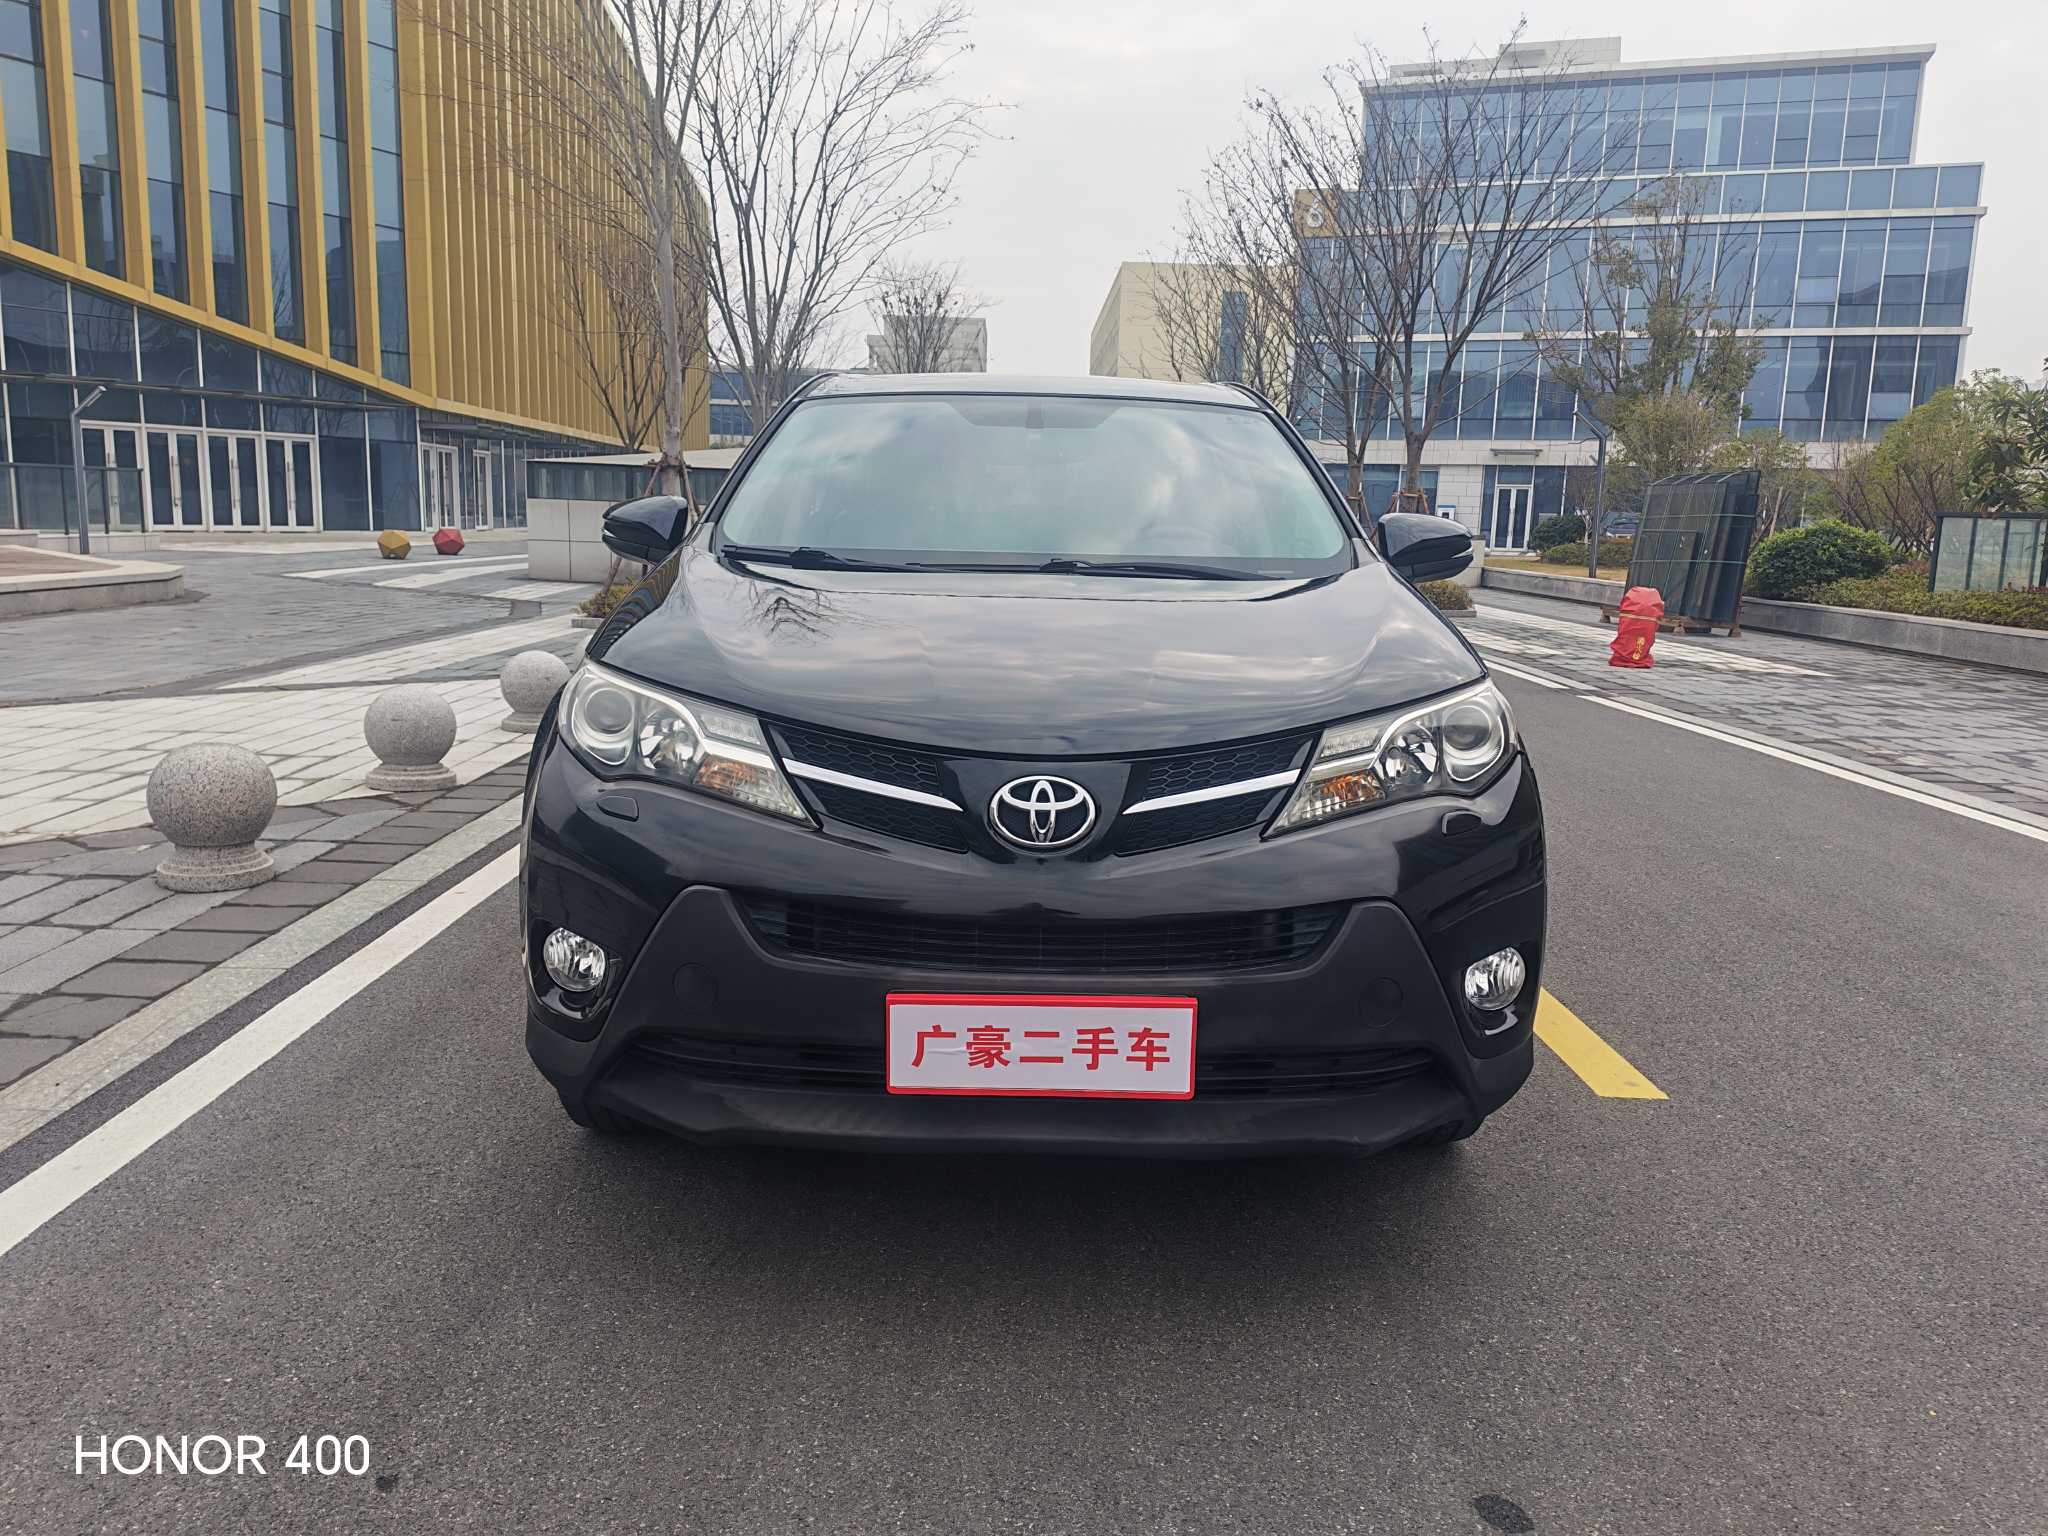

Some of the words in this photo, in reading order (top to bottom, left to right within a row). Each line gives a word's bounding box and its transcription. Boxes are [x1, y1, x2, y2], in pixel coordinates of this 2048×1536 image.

[911, 1025, 1171, 1072] 广豪二手车
